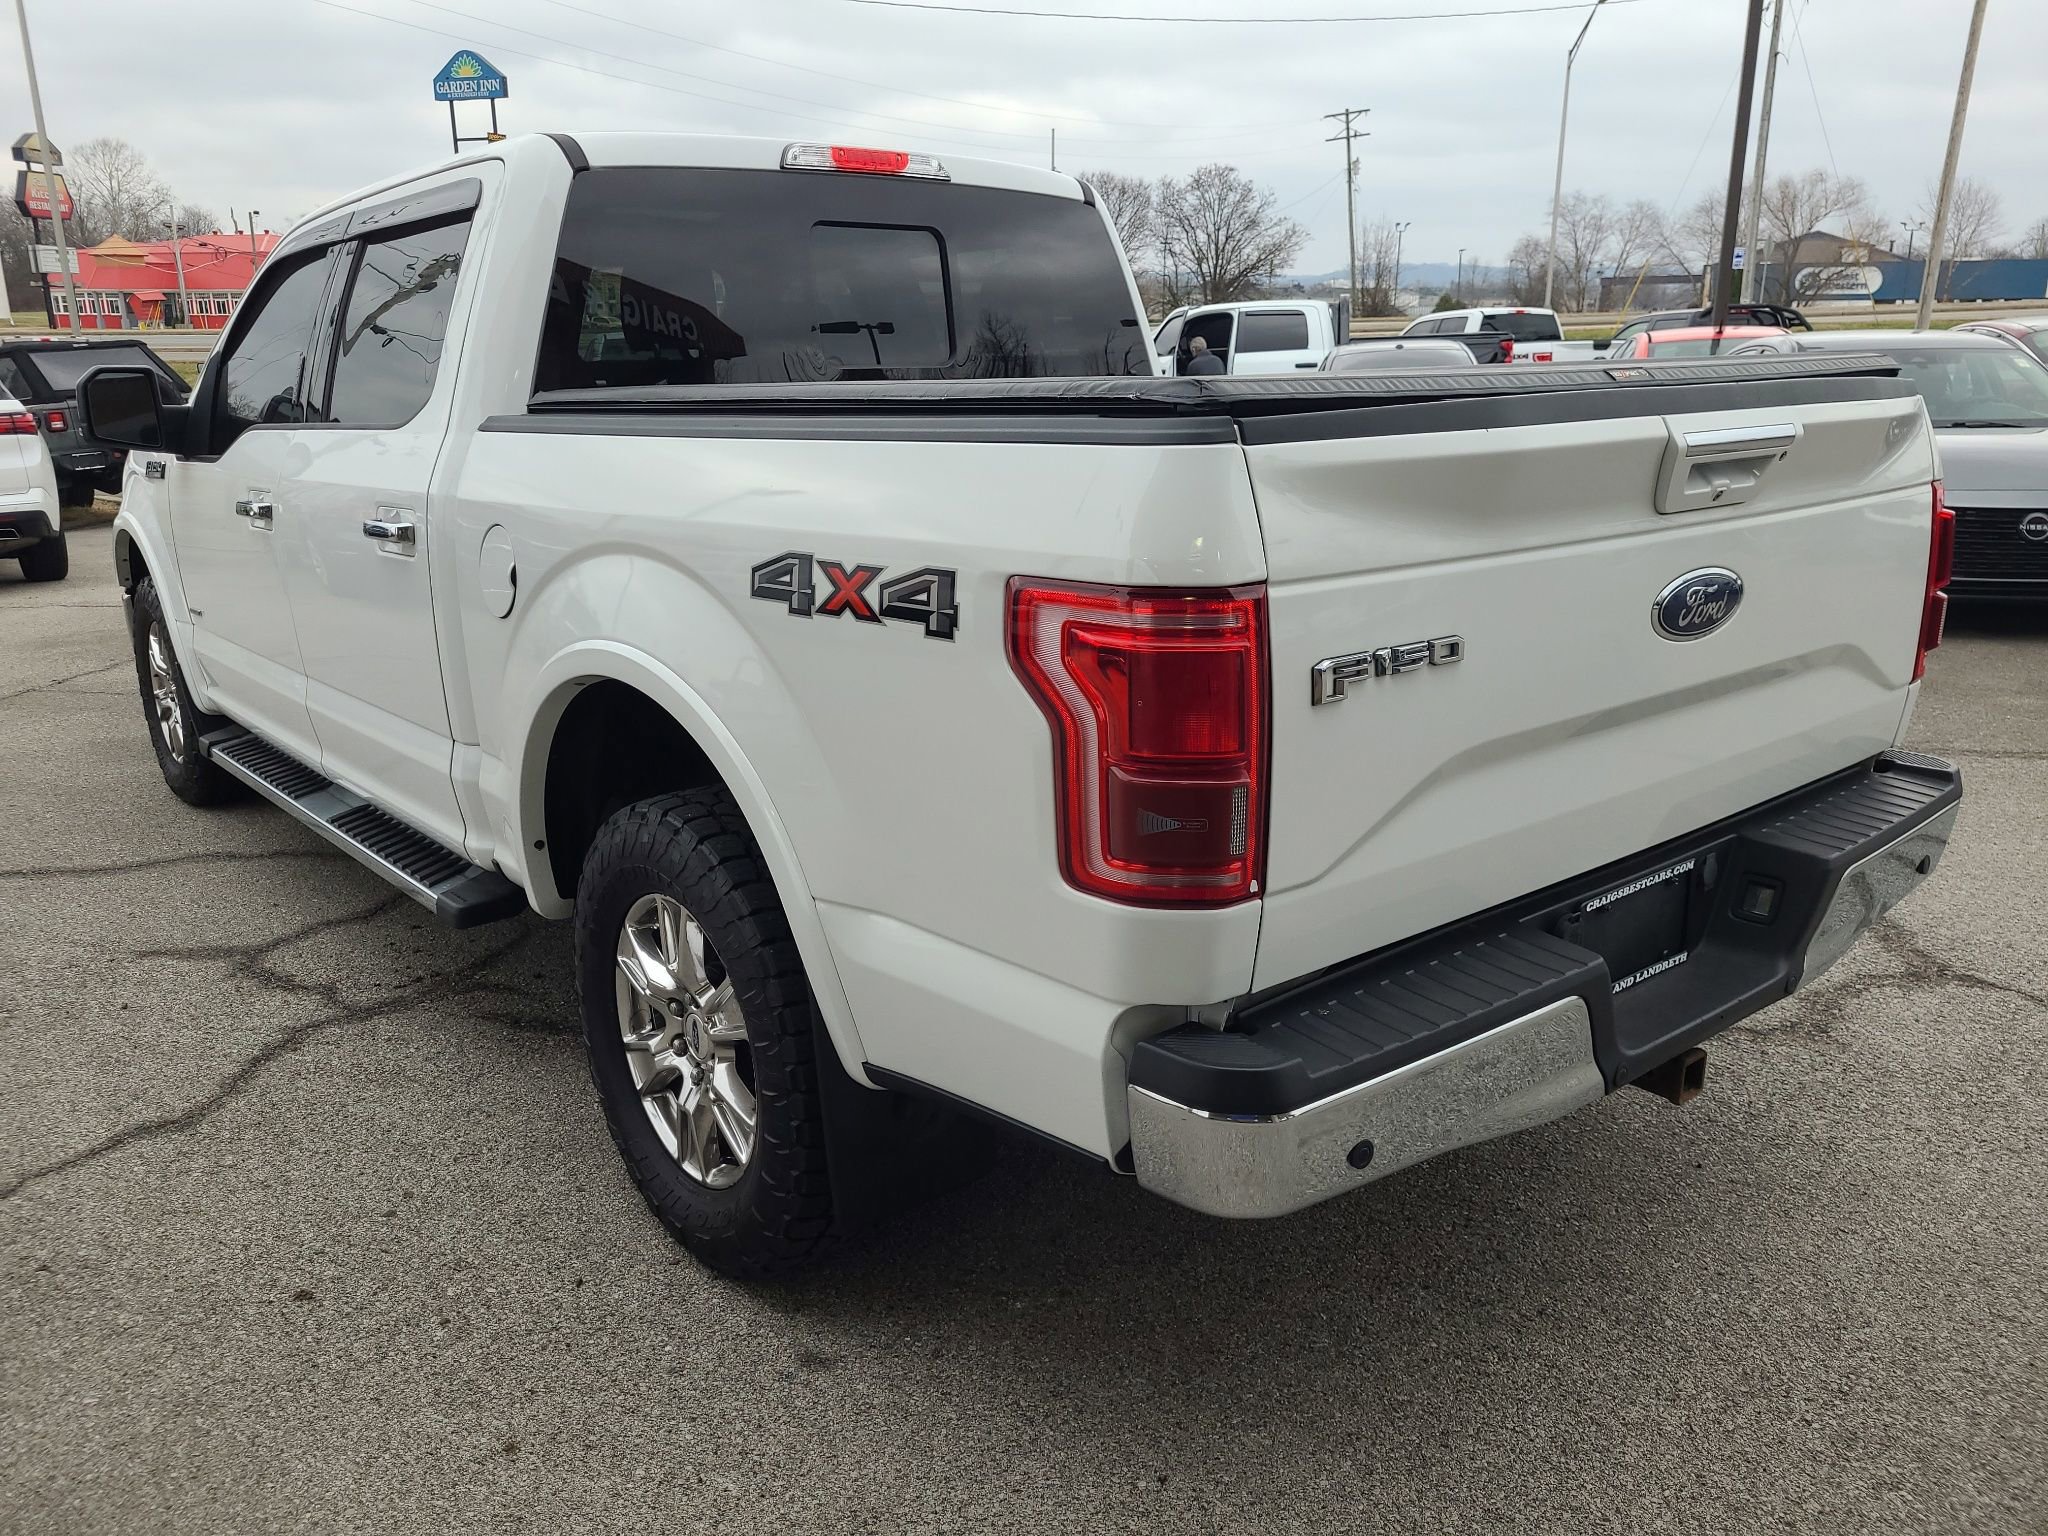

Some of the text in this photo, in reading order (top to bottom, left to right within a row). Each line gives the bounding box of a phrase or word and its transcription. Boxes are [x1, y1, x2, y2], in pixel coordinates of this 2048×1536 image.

[436, 79, 500, 94] GARDEN INN
[1678, 584, 1730, 627] Ford
[1311, 634, 1465, 706] F150
[1586, 858, 1696, 913] CRAIGSBESTCARS.COM
[1612, 952, 1688, 994] AND LANDRETH
